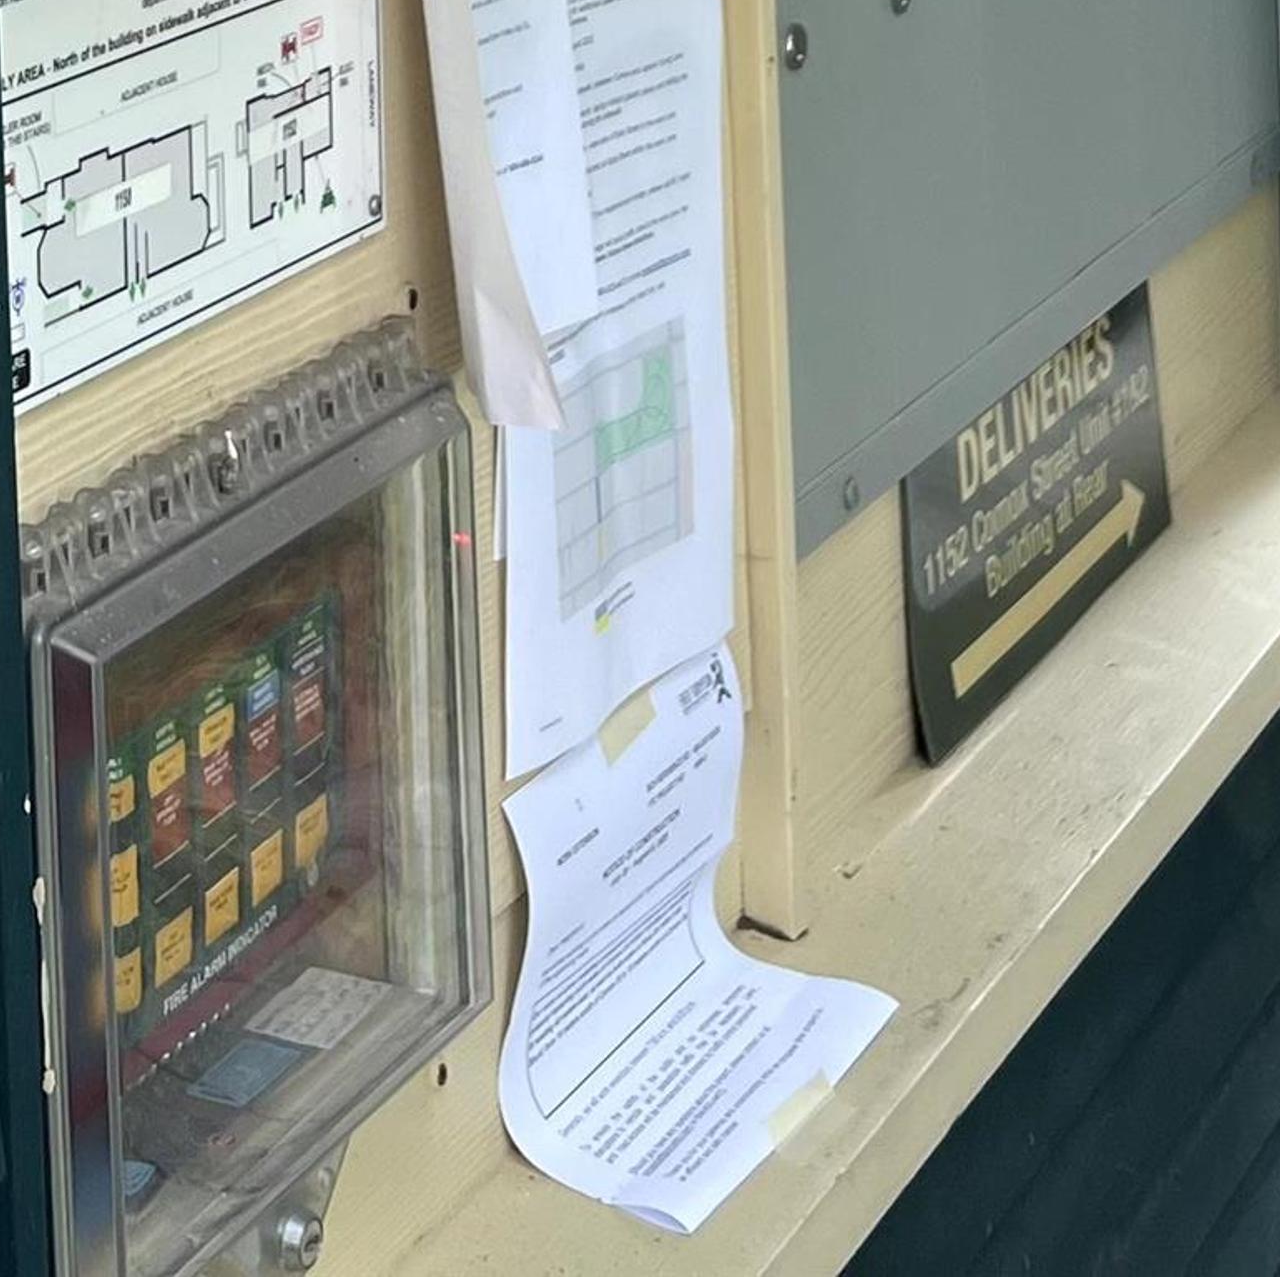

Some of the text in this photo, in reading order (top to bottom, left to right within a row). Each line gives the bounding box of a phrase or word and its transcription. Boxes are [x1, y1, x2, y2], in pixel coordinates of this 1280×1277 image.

[19, 63, 45, 84] AREA
[52, 50, 80, 72] North
[92, 41, 108, 59] the
[108, 28, 144, 52] building
[158, 8, 196, 33] sidewalk
[956, 315, 1116, 504] DELIVERIES
[923, 524, 969, 595] 1152
[971, 478, 1030, 553] Comox
[1030, 439, 1081, 502] Street
[984, 459, 1110, 598] Building at Rear
[162, 981, 190, 1017] FIRE
[189, 950, 227, 996] ALARM
[226, 904, 278, 963] INDICATOR
